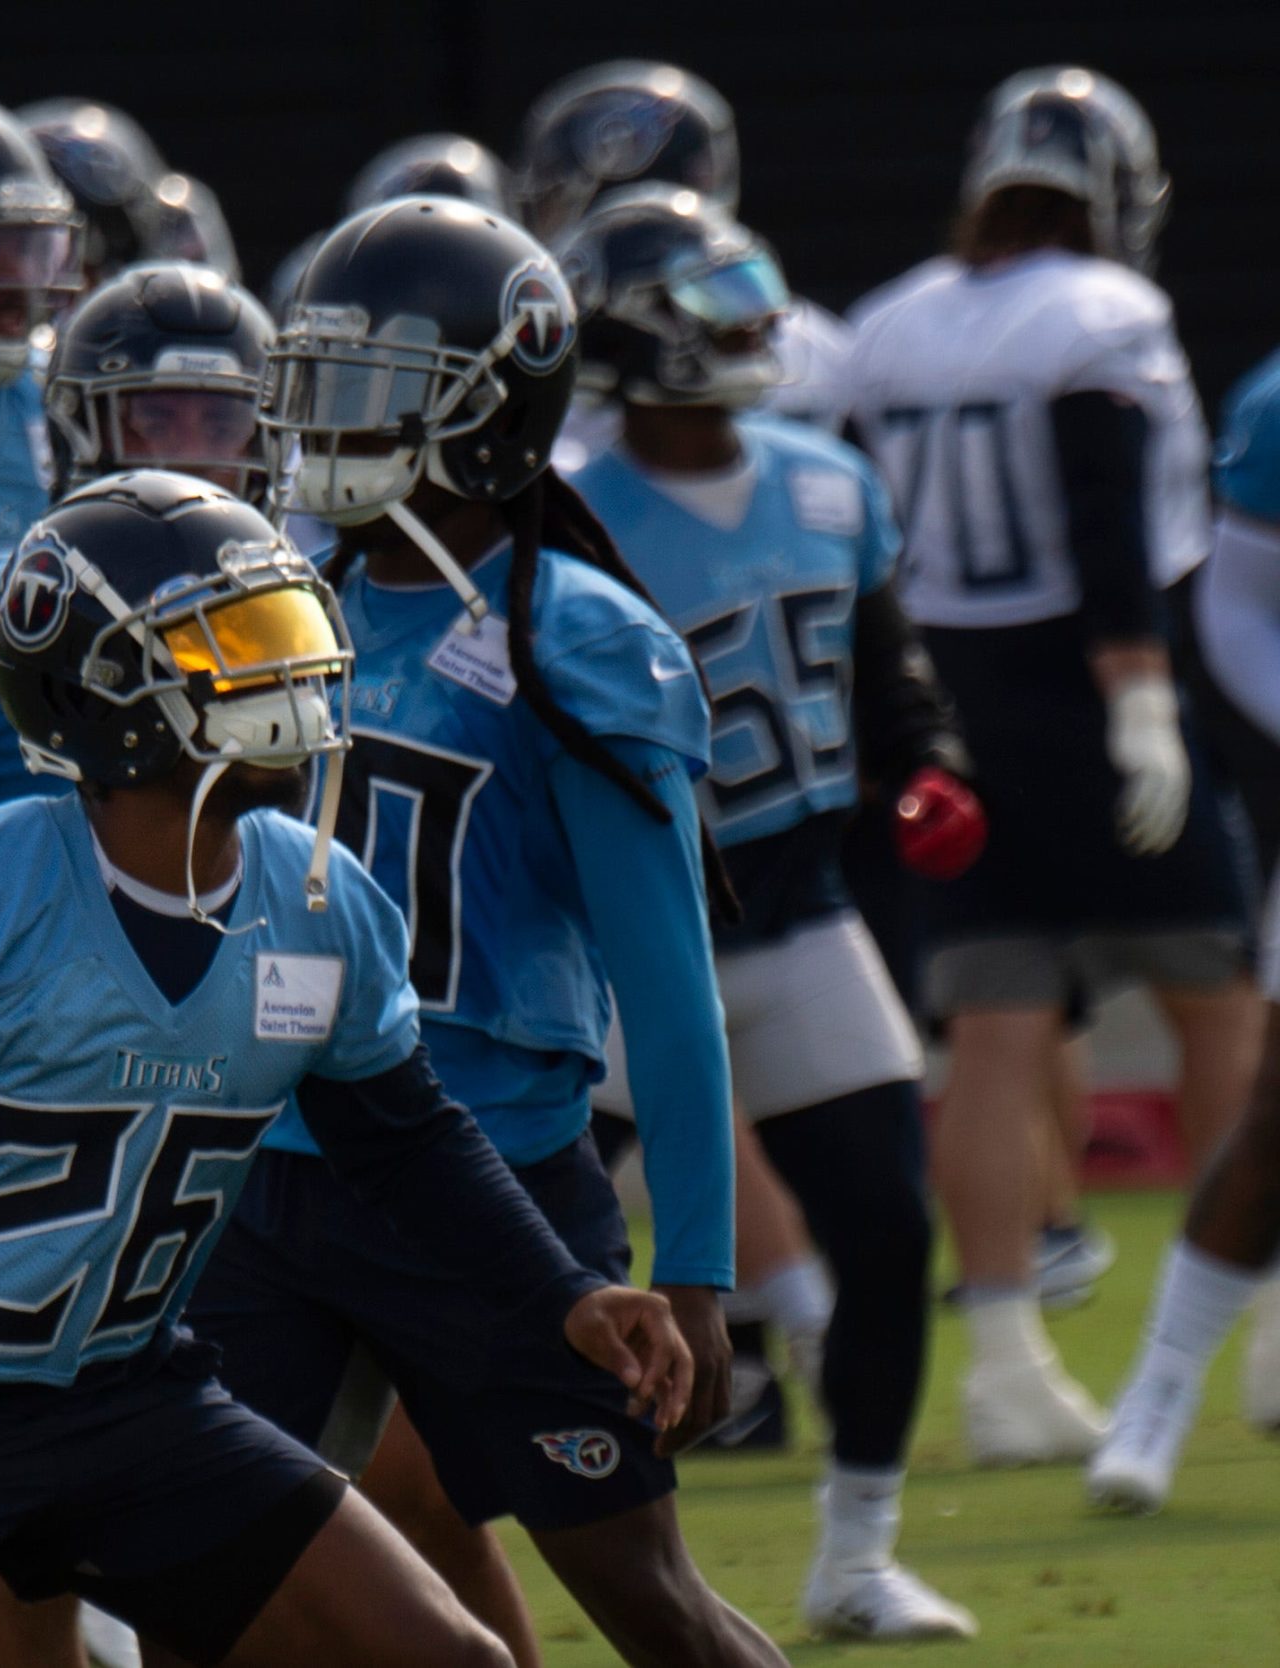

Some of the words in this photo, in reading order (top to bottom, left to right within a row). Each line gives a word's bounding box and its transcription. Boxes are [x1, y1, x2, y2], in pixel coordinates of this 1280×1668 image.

[262, 1000, 316, 1017] Ascension
[260, 1018, 287, 1033] Saint
[118, 1047, 226, 1093] TITANS
